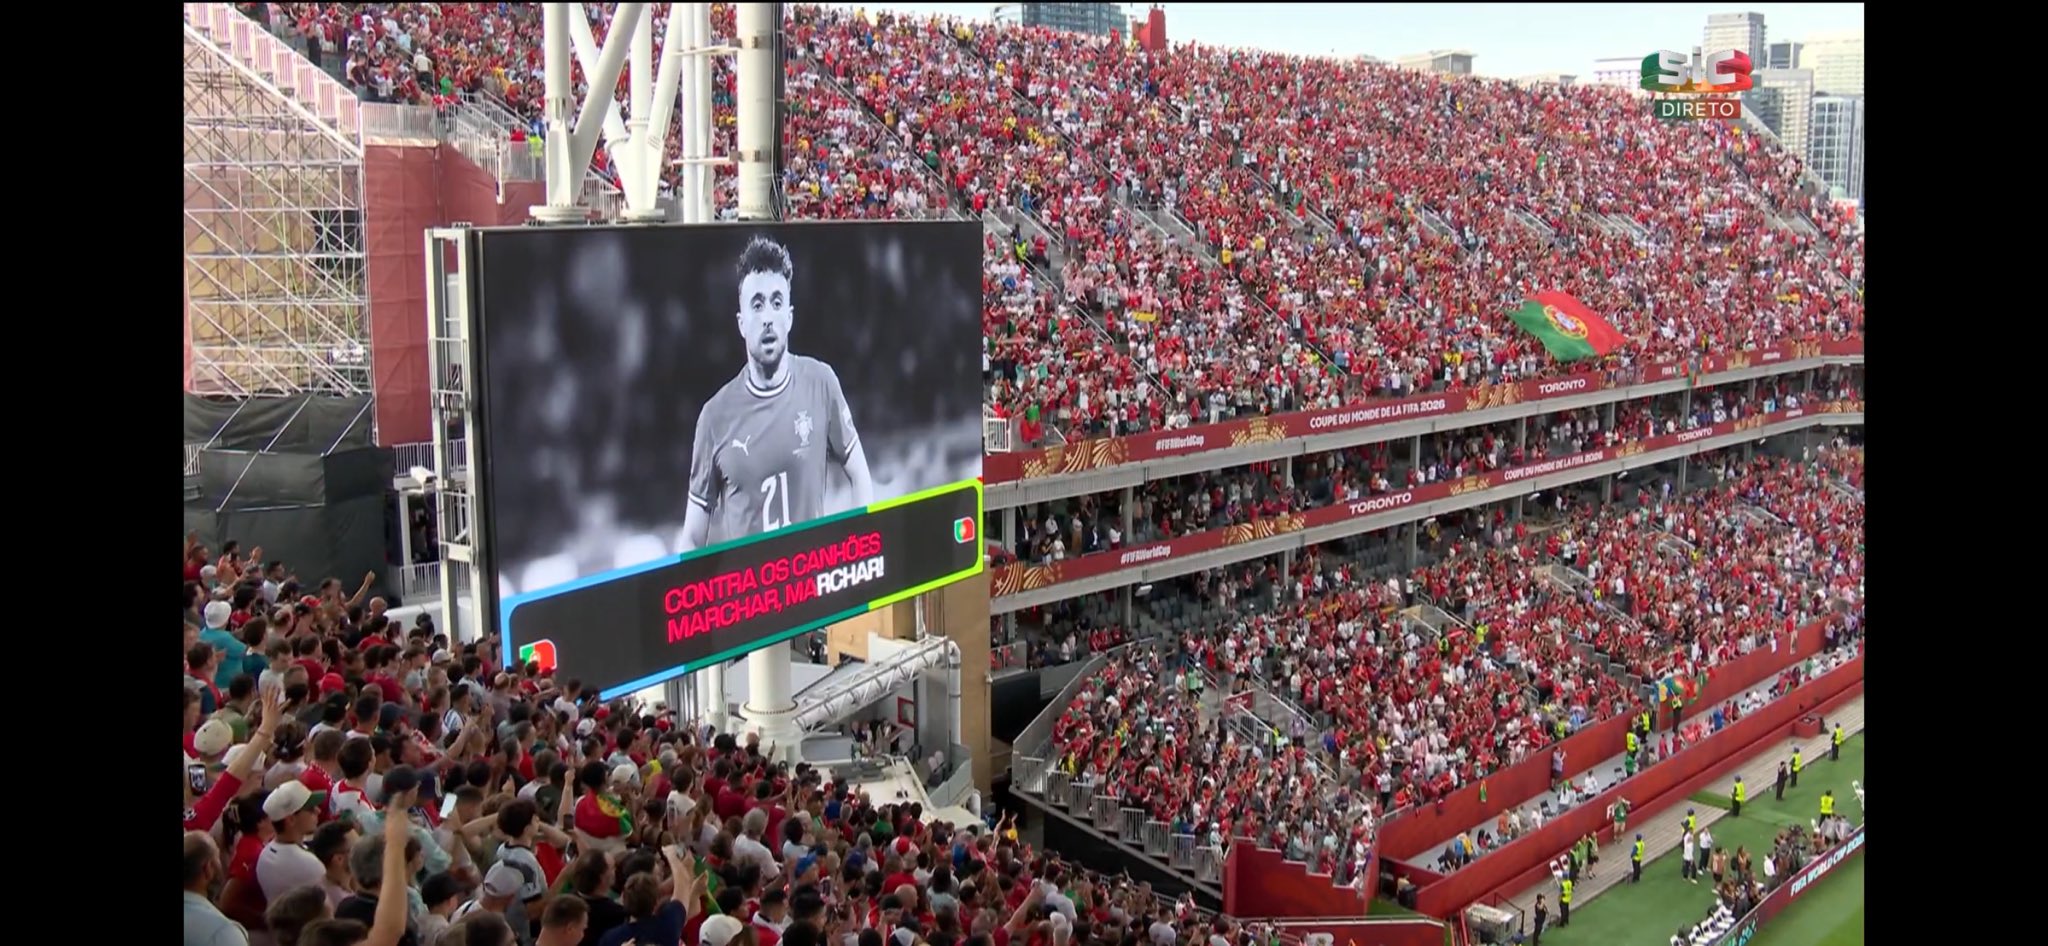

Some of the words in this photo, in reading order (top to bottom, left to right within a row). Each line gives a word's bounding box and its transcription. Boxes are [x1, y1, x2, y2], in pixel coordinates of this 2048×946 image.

[1539, 379, 1586, 394] TORONTO
[1310, 414, 1338, 428] COUPE
[1339, 412, 1351, 424] DU
[1351, 408, 1380, 422] MONDE
[1380, 406, 1391, 417] DE
[1391, 405, 1402, 416] LA
[1402, 403, 1419, 414] FIFA
[1420, 399, 1446, 412] 2026
[1155, 434, 1205, 451] #FIFAWorldCup
[1676, 427, 1713, 442] TORONTO
[1504, 467, 1524, 481] COUPE
[1525, 465, 1535, 477] DU
[1534, 462, 1555, 475] MONDE
[1555, 459, 1563, 470] DE
[1563, 457, 1572, 468] LA
[1571, 455, 1584, 466] FIFA
[761, 471, 792, 533] 21
[1349, 492, 1412, 515] TORONTO
[1120, 544, 1171, 565] #FIFAWorldCup
[665, 567, 758, 614] CONTRA
[759, 556, 790, 587] OS
[792, 532, 882, 575] CANHÕES
[667, 588, 783, 643] MARCHAR,
[785, 556, 884, 604] MARCHAR!
